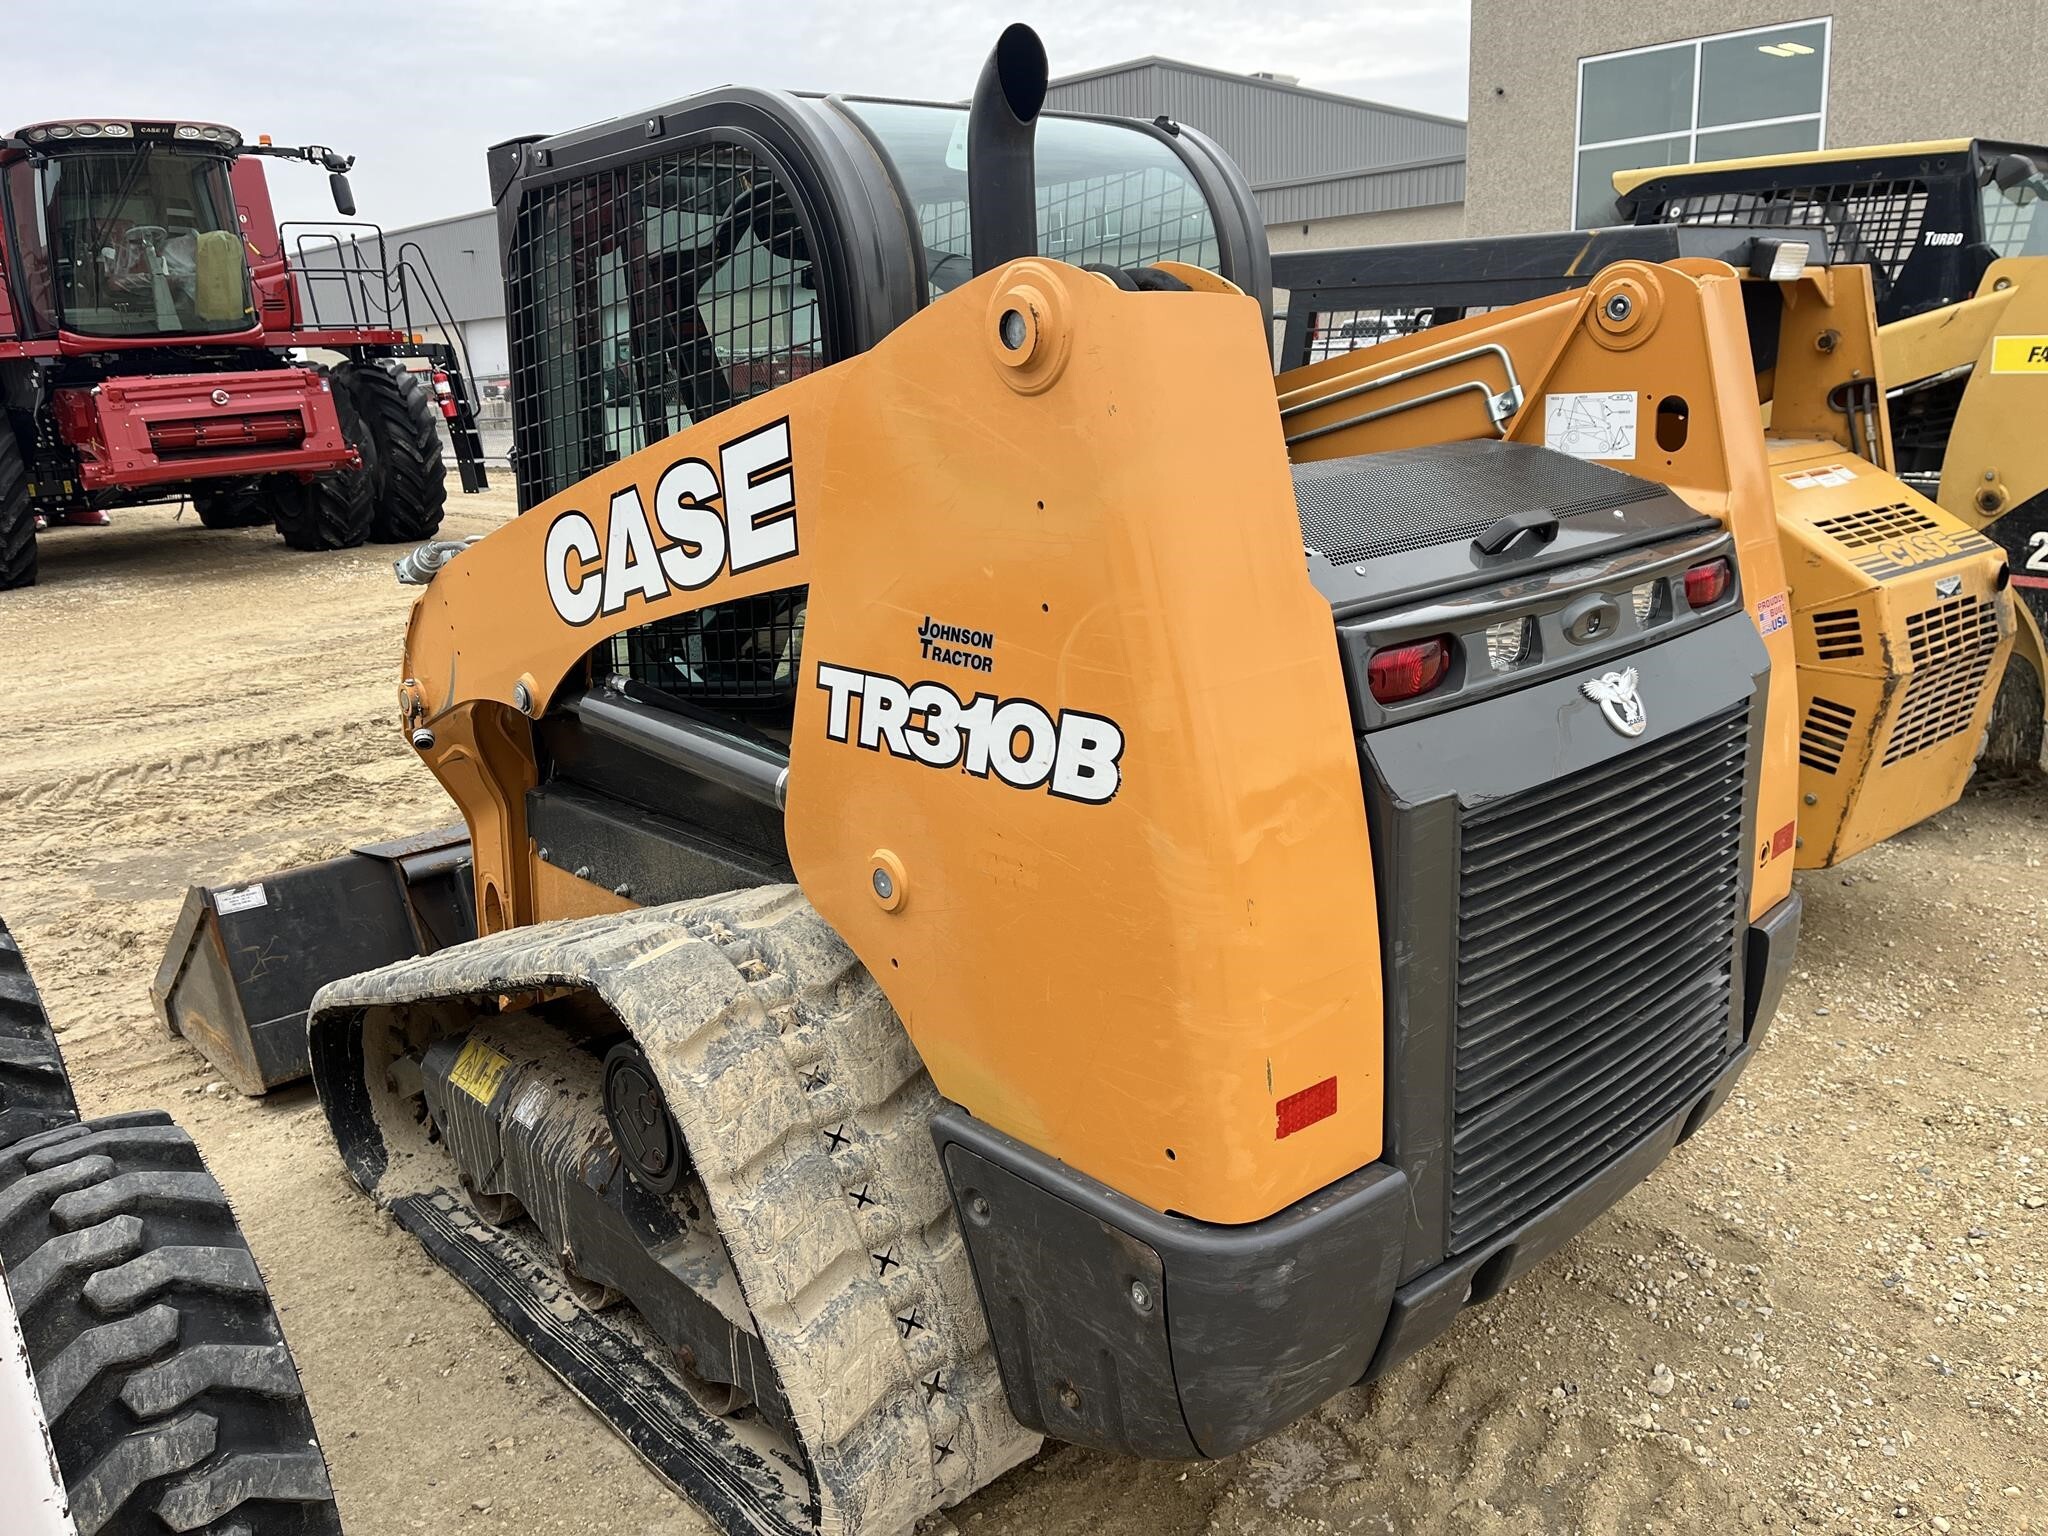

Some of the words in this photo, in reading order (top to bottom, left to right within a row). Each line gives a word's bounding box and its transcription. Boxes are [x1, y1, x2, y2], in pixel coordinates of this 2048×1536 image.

[543, 415, 799, 627] CASE
[1877, 530, 1964, 567] CASE
[1757, 594, 1784, 609] PROUDLY
[917, 616, 993, 650] JOHNSON
[1771, 614, 1787, 630] USA
[920, 638, 993, 673] TRACTOR
[816, 661, 1125, 806] TR310B
